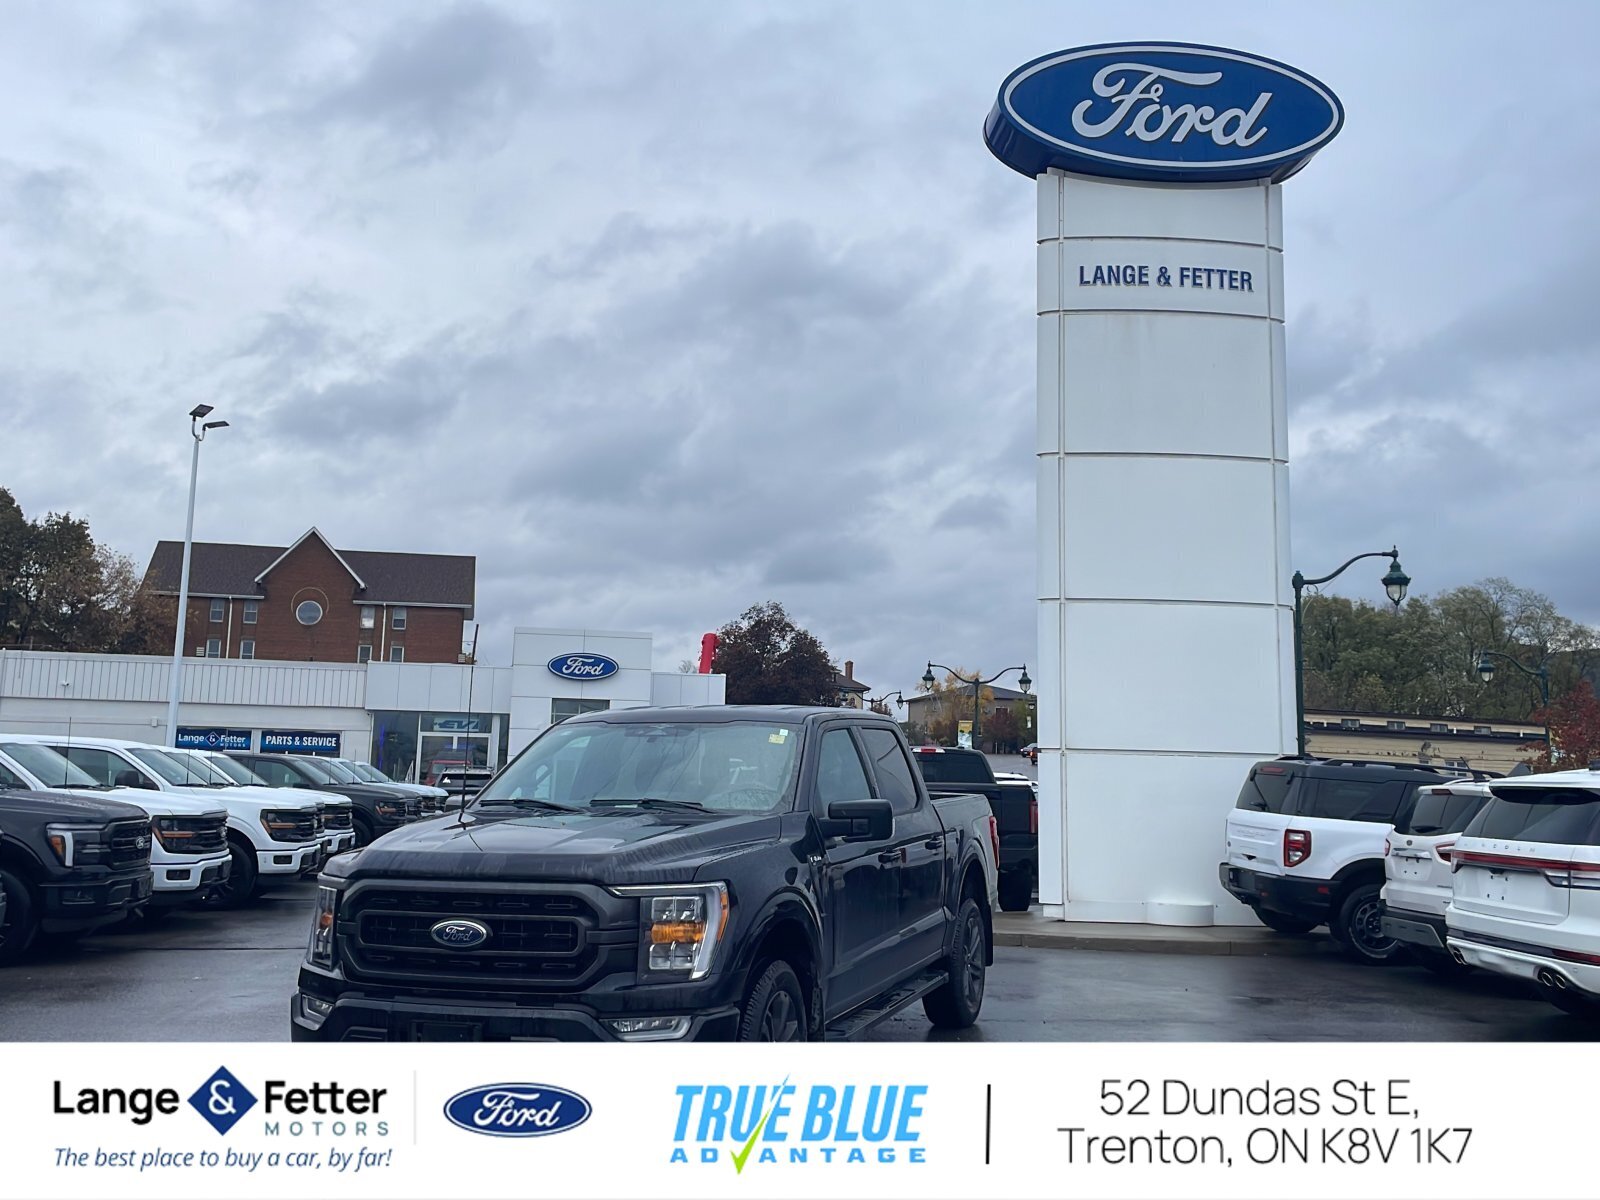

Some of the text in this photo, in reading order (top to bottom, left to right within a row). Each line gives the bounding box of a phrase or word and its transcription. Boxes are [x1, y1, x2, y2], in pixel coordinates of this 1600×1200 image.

[1072, 62, 1272, 147] Ford
[1079, 265, 1254, 292] LANGE & FETTER
[562, 657, 604, 675] Ford
[178, 733, 204, 744] Lange
[220, 734, 246, 743] Fetter
[265, 735, 337, 747] PARTS & SERVICE
[443, 926, 473, 940] Ford
